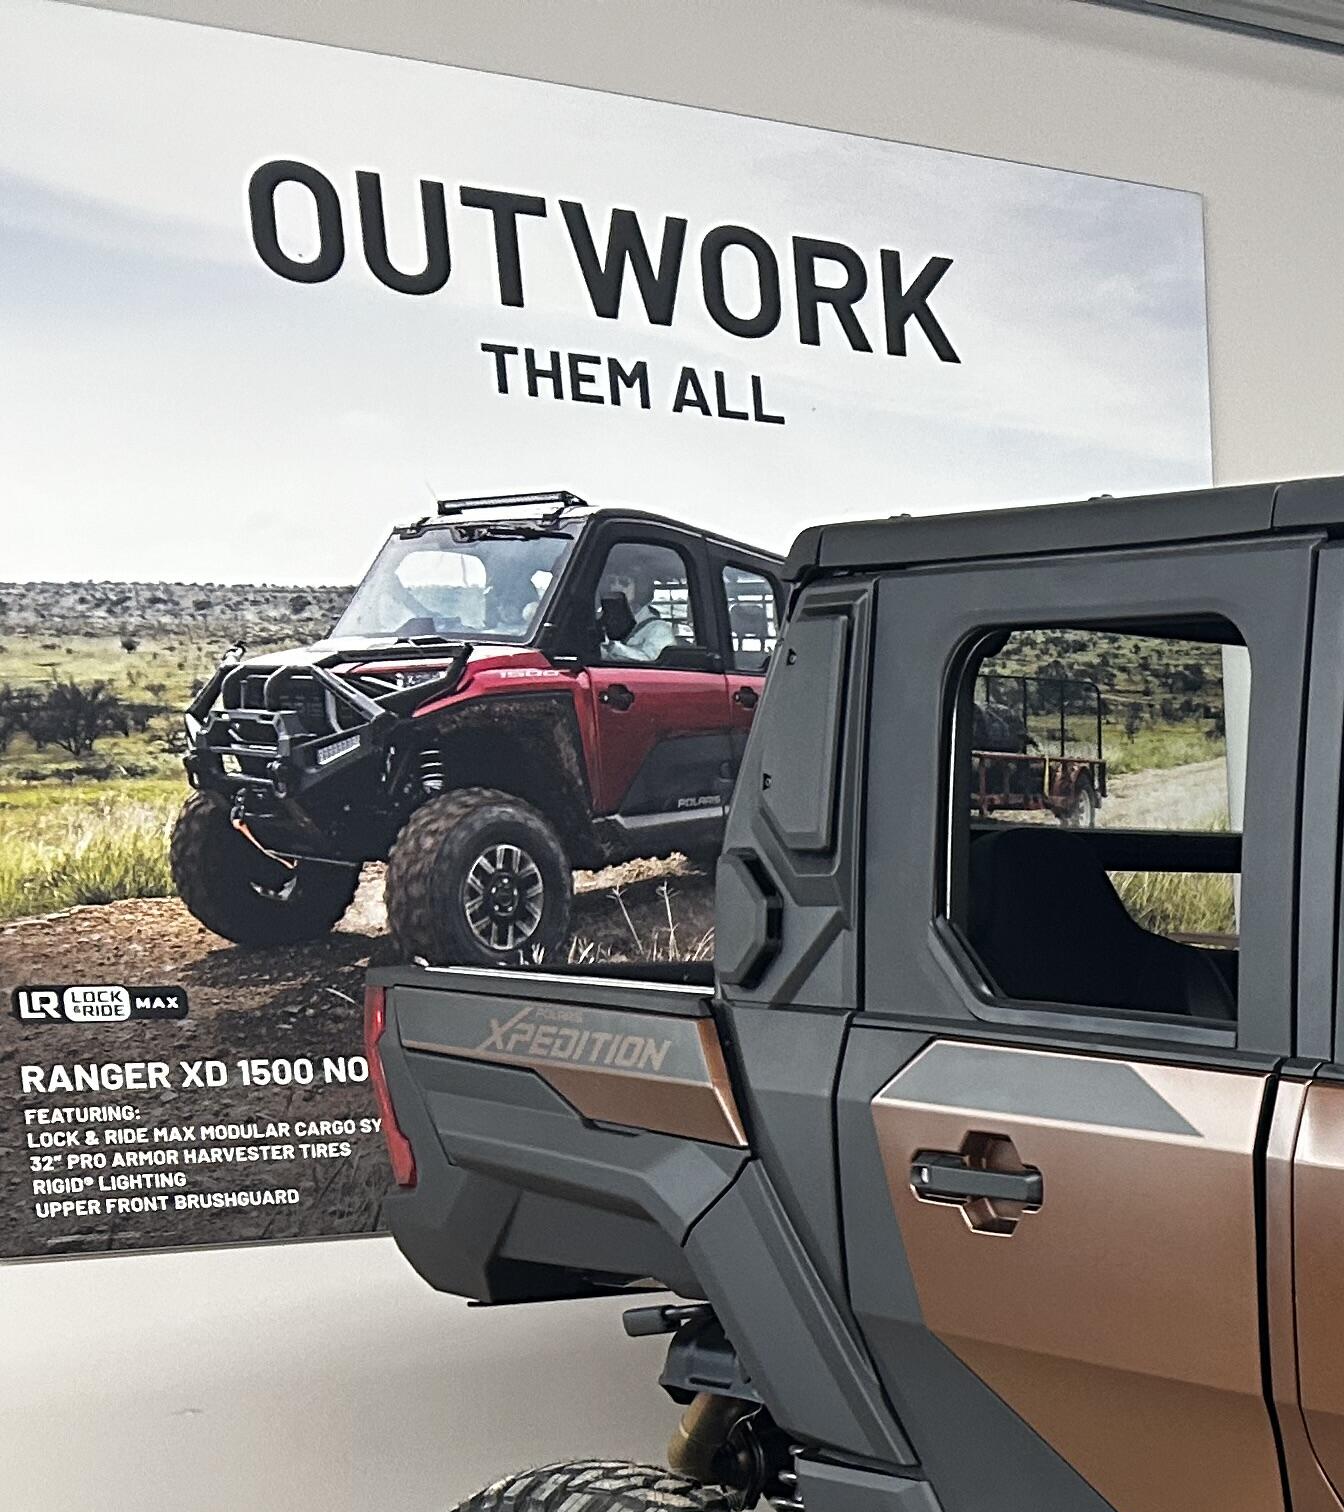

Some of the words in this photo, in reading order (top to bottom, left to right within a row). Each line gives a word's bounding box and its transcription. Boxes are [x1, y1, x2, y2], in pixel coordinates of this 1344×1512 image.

[248, 158, 962, 364] OUTWORK
[481, 342, 651, 410] THEM
[672, 366, 786, 426] ALL
[71, 990, 122, 1004] LOCK
[135, 996, 179, 1010] MAX
[476, 1005, 673, 1072] XPEDITION
[21, 1062, 171, 1093] RANGER
[179, 1060, 228, 1088] XD
[237, 1058, 314, 1086] 1500
[323, 1055, 369, 1083] NO
[24, 1105, 141, 1125] FEATURING:
[27, 1130, 80, 1148] LOCK
[84, 1129, 100, 1146] &
[104, 1127, 149, 1145] RIDE
[153, 1125, 196, 1143] MAX
[200, 1121, 291, 1141] MODULAR
[294, 1118, 356, 1137] CARGO
[359, 1117, 382, 1134] SY
[67, 1152, 107, 1170] PRO
[111, 1149, 179, 1167] ARMOR
[183, 1144, 295, 1164] HARVESTER
[298, 1141, 352, 1159] TIRES
[98, 1171, 187, 1192] LIGHTING
[35, 1199, 101, 1219] UPPER
[105, 1195, 169, 1214] FRONT
[174, 1188, 300, 1210] BRUSHGUARD
